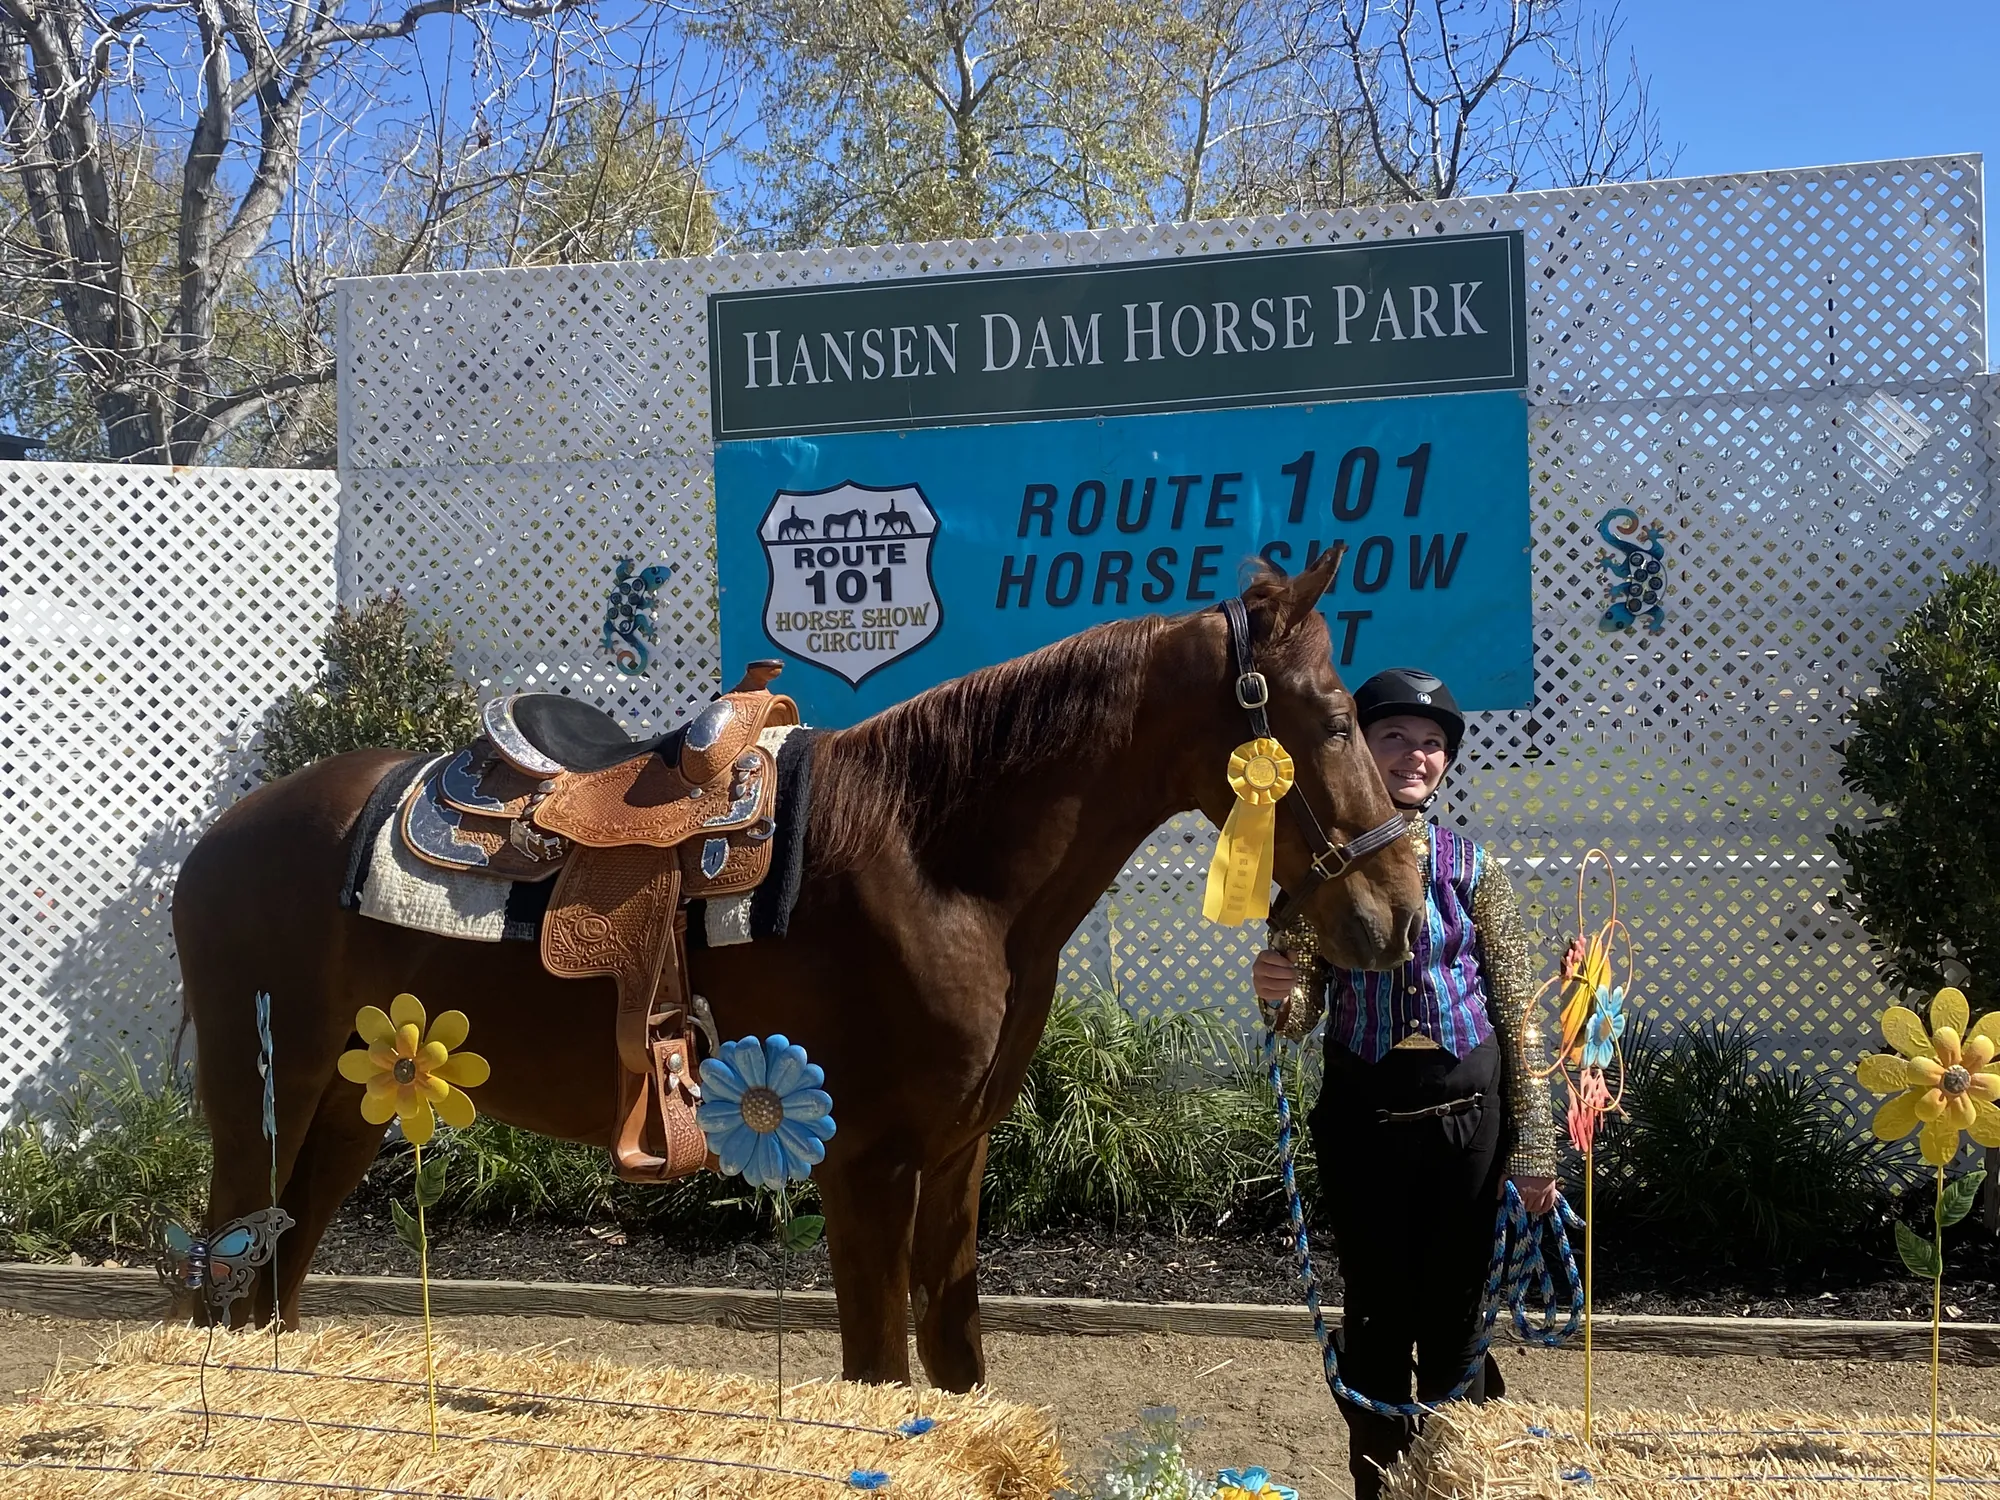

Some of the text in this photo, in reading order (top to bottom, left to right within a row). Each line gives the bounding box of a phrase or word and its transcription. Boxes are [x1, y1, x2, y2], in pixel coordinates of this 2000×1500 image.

[743, 281, 1488, 389] HANSEN DAM HORSE PARK
[1017, 442, 1432, 538] ROUTE 101
[794, 543, 907, 568] ROUTE
[805, 567, 893, 604] 101
[995, 544, 1224, 609] HORSE
[775, 602, 931, 632] HORSE SHOW
[806, 630, 899, 653] CIRCUIT
